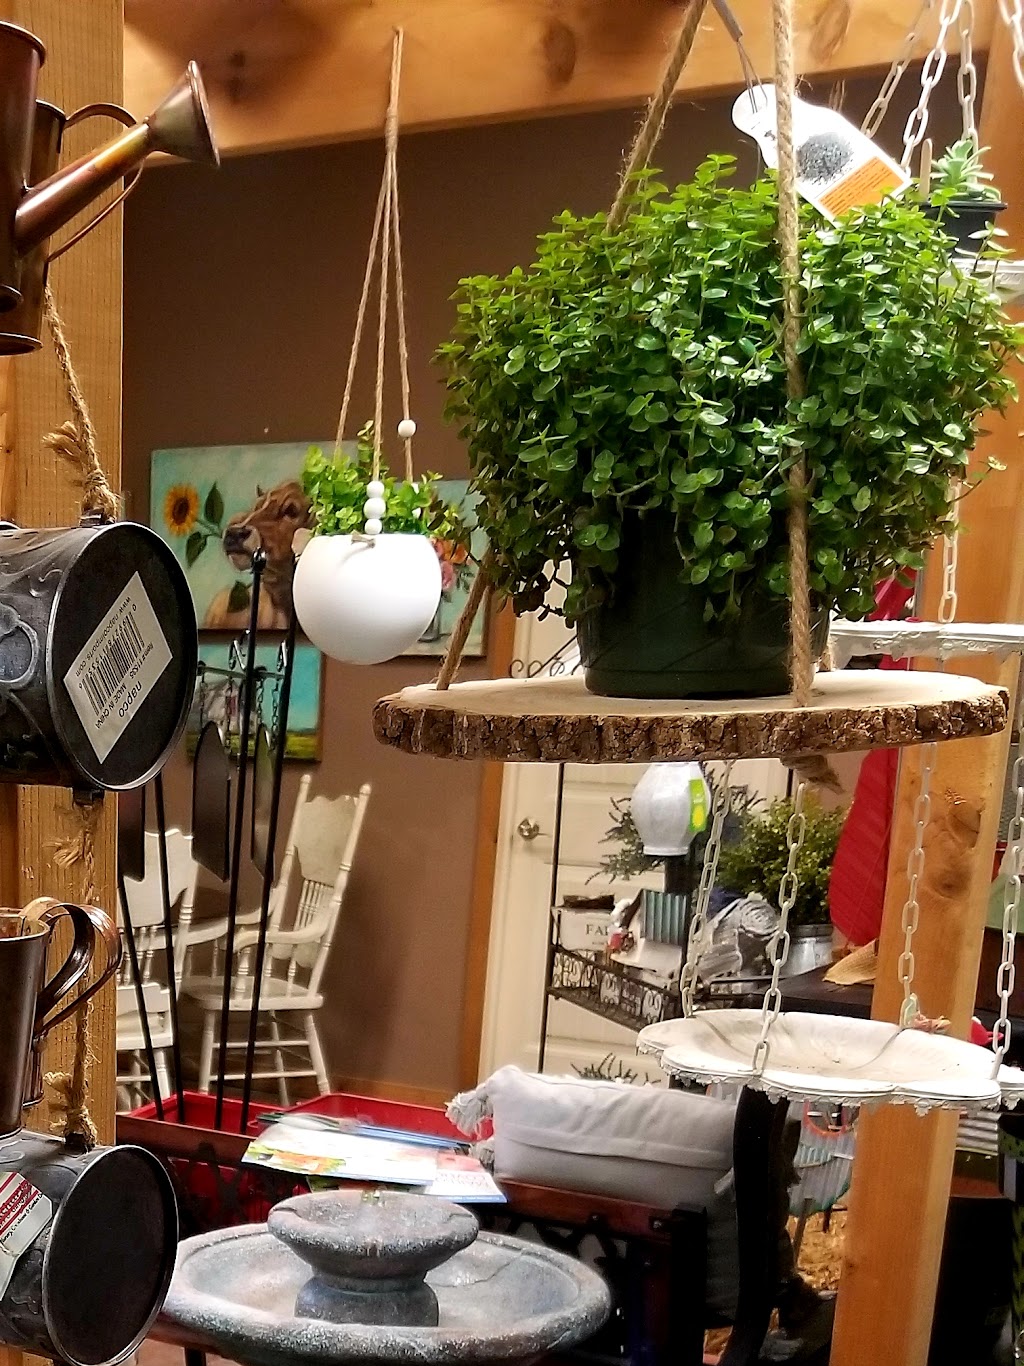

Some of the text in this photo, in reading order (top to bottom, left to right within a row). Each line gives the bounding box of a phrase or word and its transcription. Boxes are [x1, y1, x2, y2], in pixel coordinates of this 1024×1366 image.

[112, 682, 127, 705] MADE
[117, 679, 142, 719] napco
[95, 706, 111, 730] CHINA
